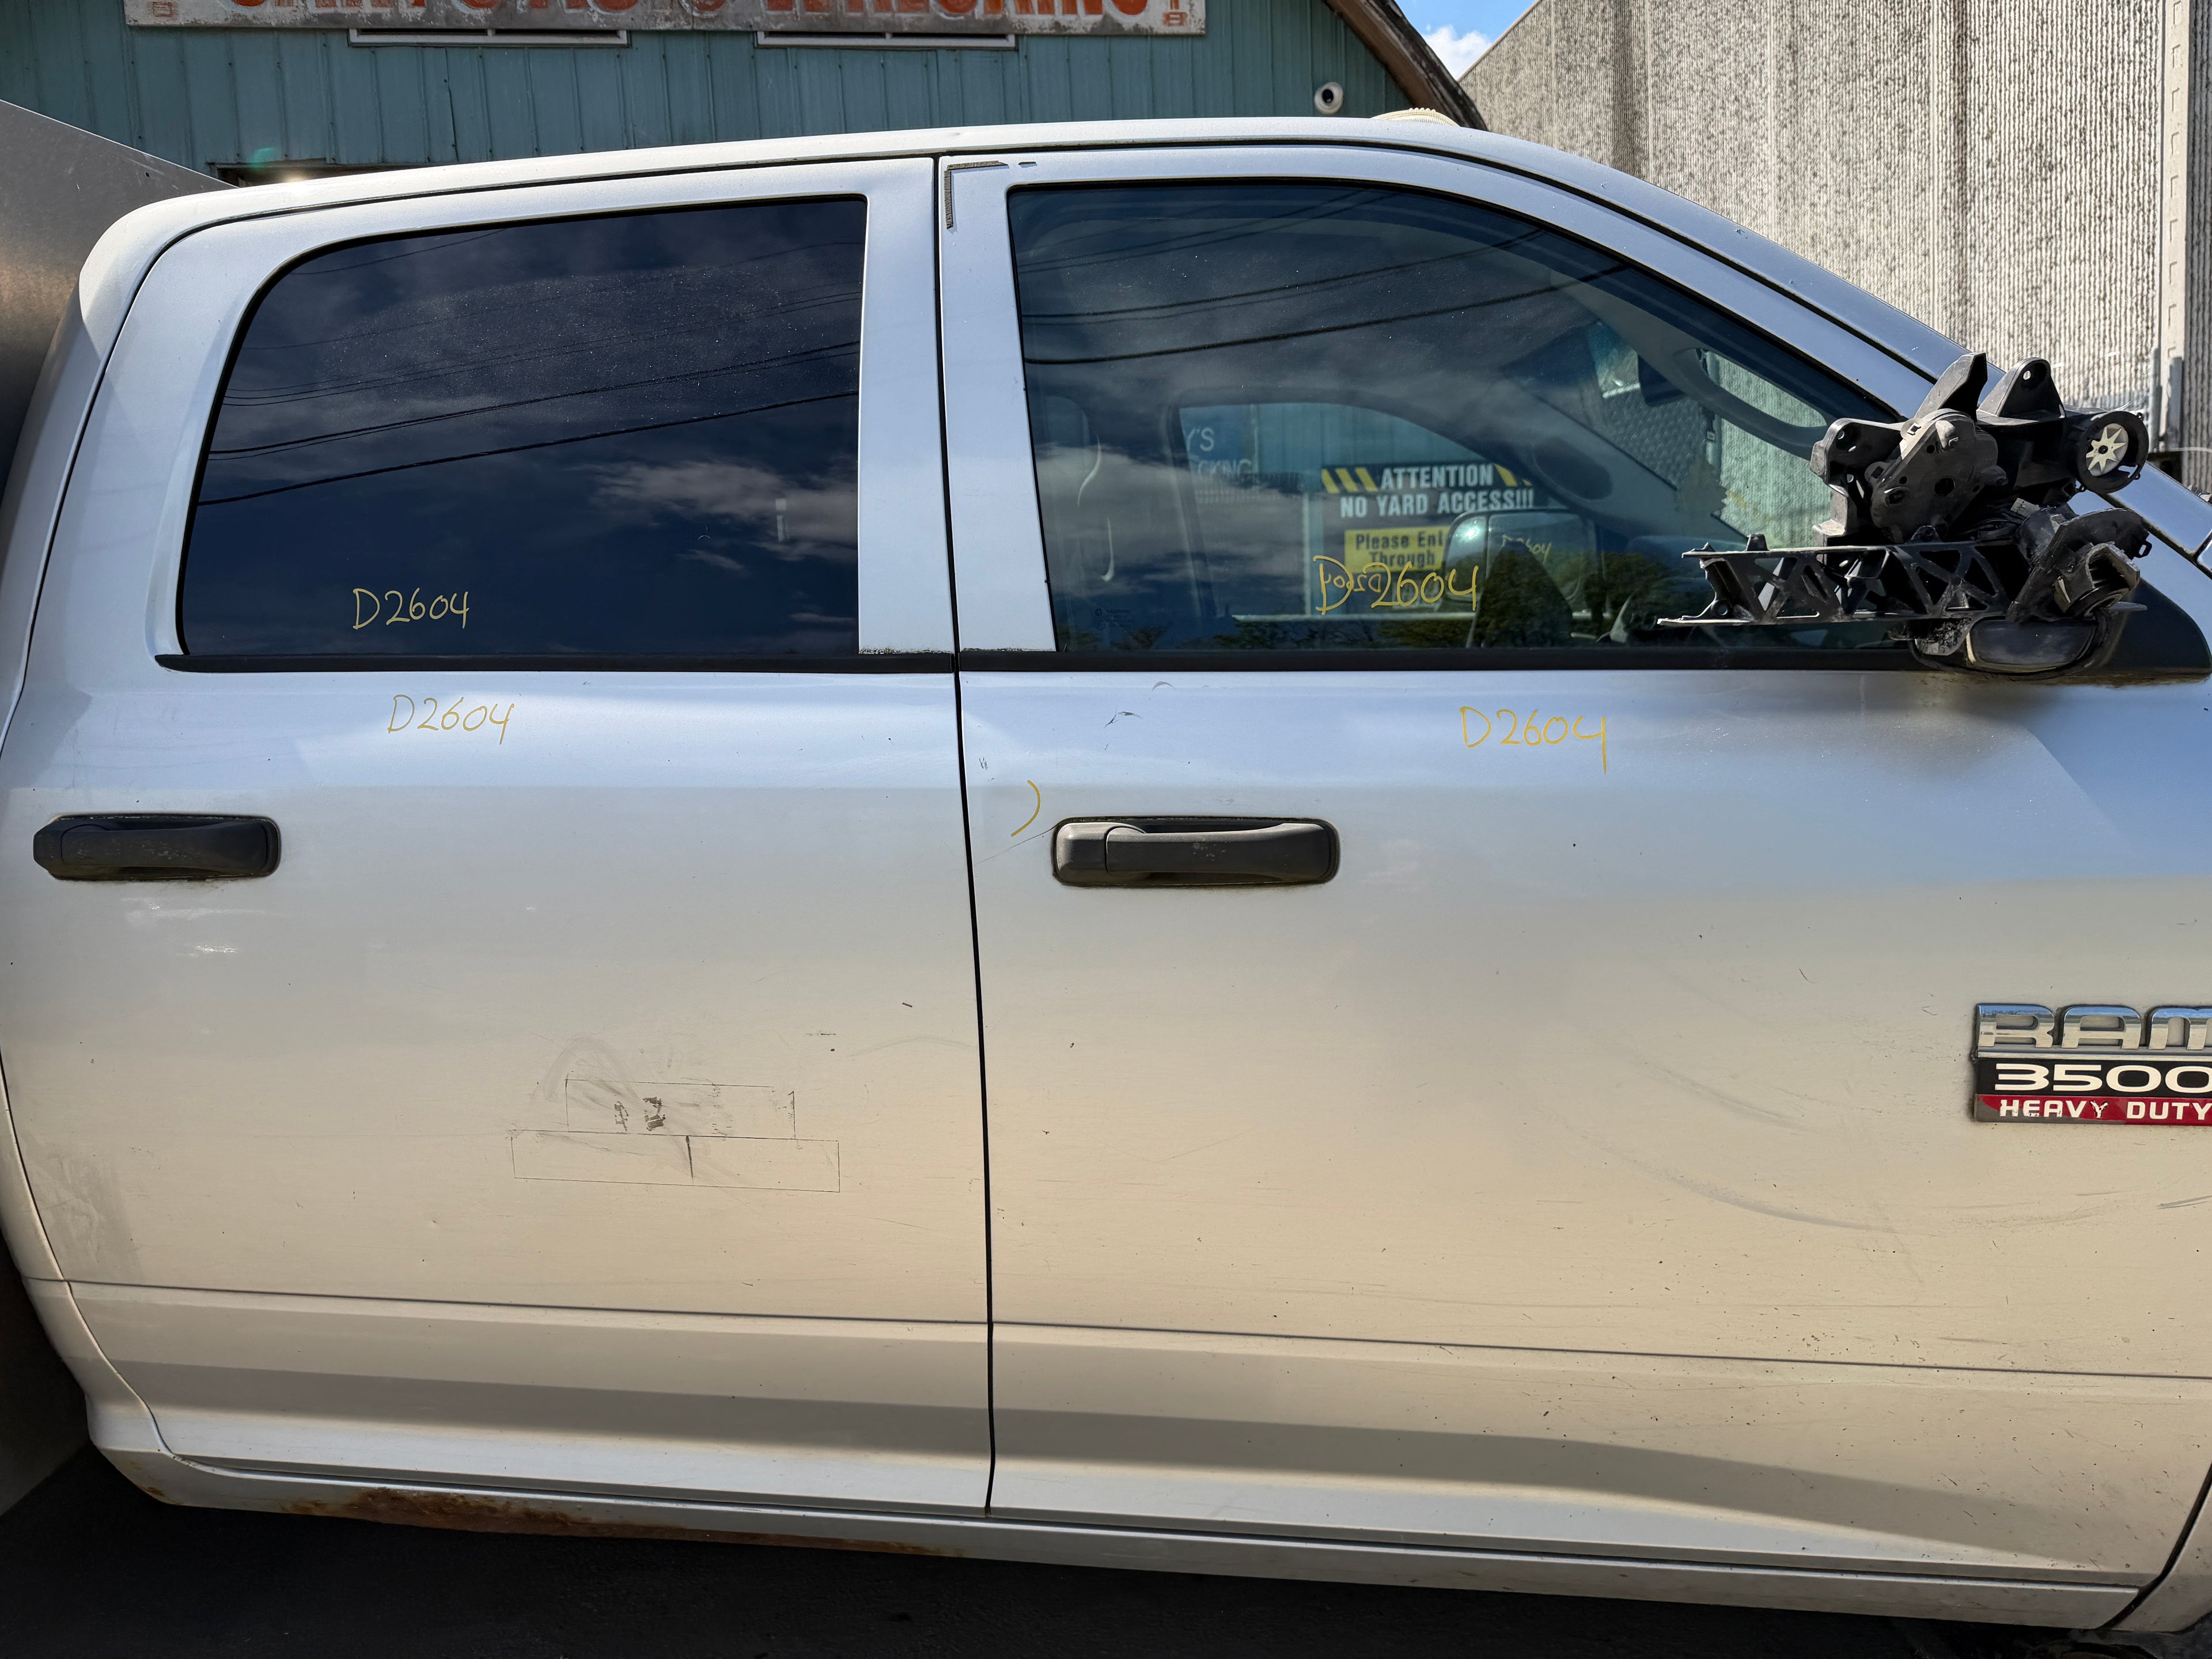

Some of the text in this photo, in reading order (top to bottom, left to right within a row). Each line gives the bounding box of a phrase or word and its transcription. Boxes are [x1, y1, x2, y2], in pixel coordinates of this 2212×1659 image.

[1380, 463, 1494, 490] ATTENTION
[1340, 487, 1535, 518] NO YARD ACCESS!!!
[1355, 530, 1443, 549] Please Ent
[353, 587, 469, 630] D2604
[387, 694, 515, 745] D2604
[1459, 706, 1607, 774] D2604
[1977, 1003, 2212, 1051] RAM
[1994, 1062, 2212, 1094] 3500
[1999, 1099, 2212, 1120] HEAVY DUTY
